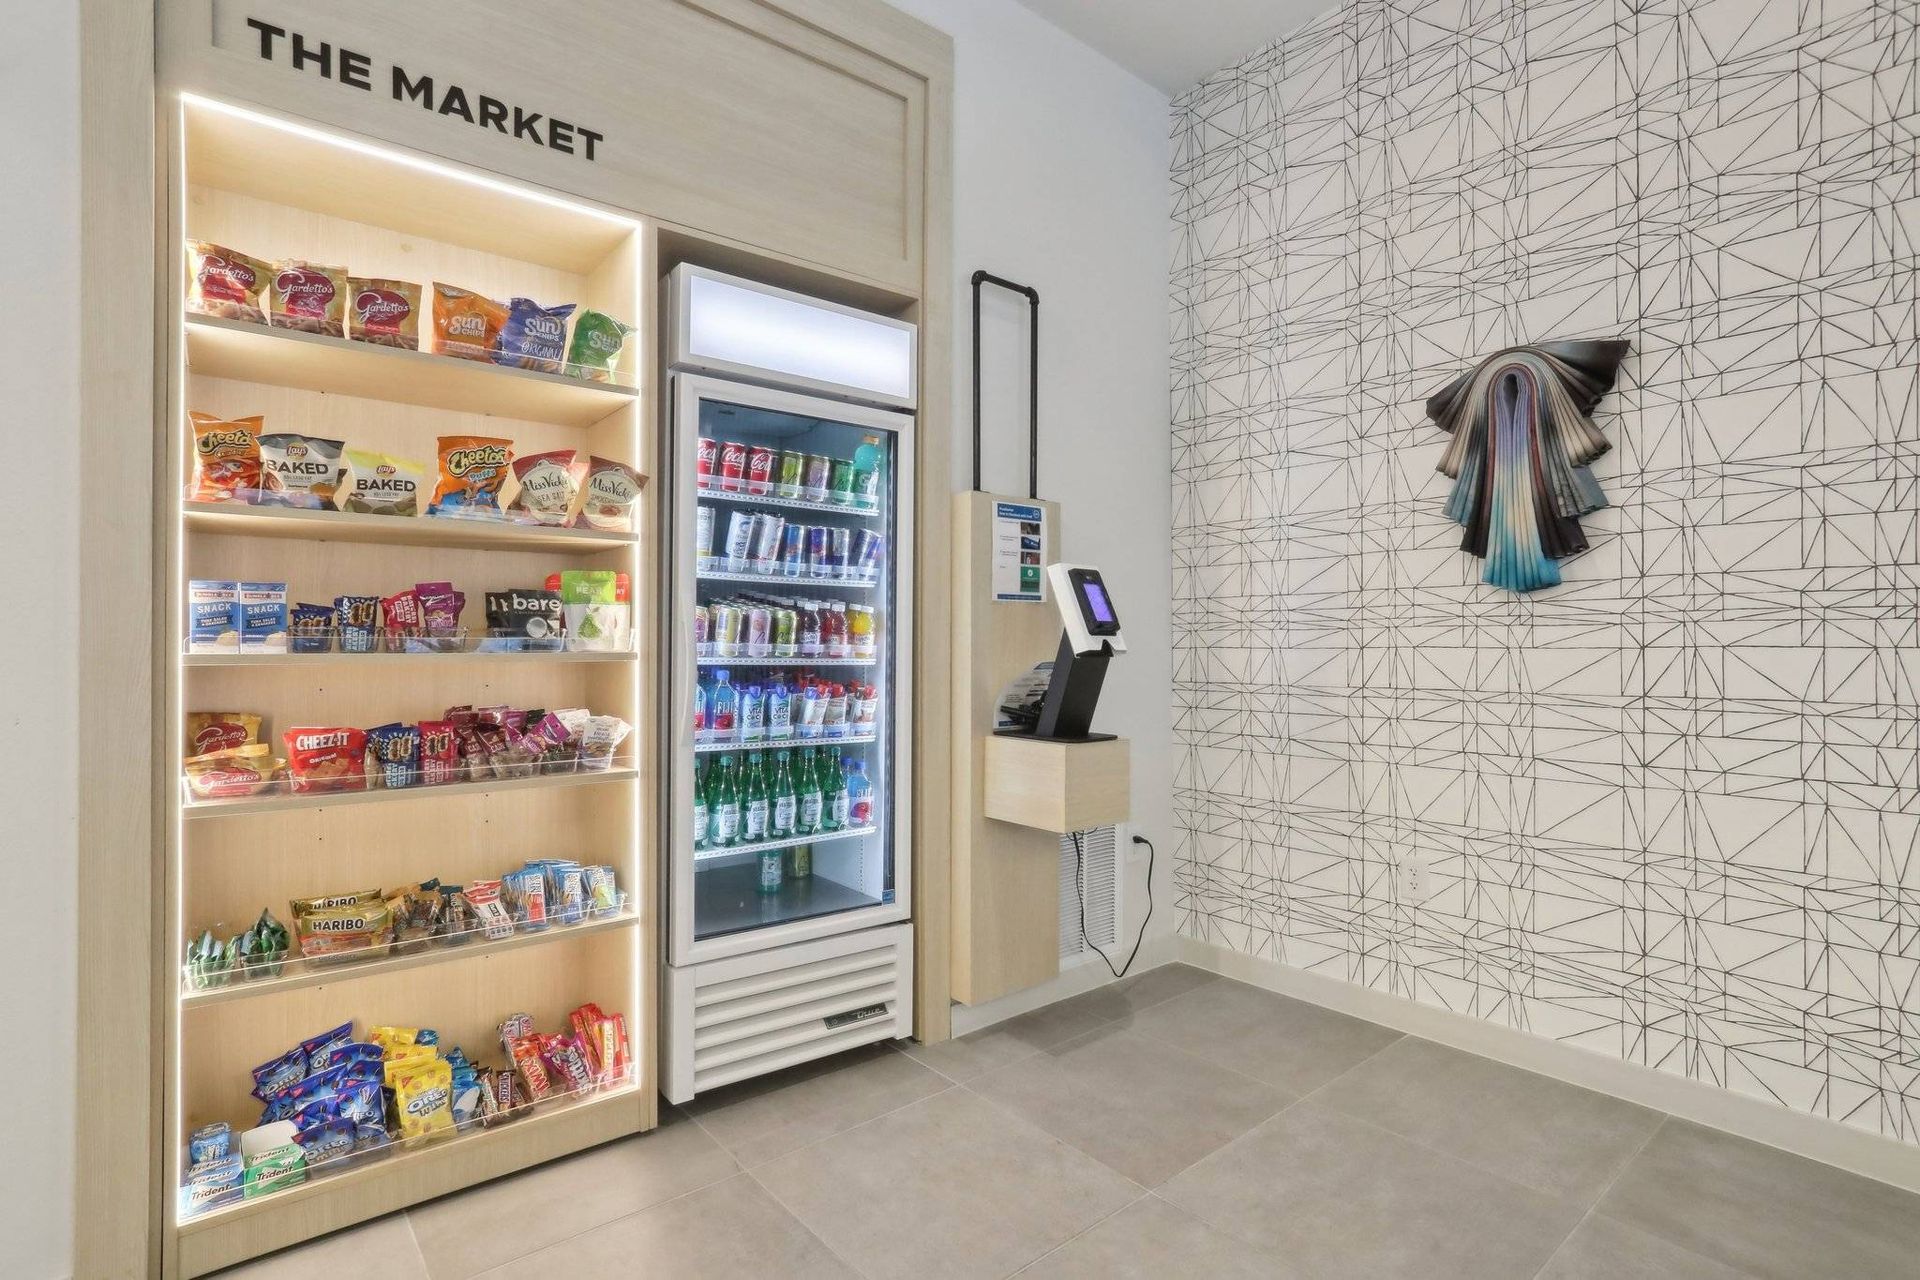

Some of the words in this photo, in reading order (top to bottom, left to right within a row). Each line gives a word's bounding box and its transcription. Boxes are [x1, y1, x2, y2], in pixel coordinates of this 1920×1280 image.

[247, 17, 372, 91] THE
[392, 65, 603, 161] MARKET
[276, 269, 333, 304] Gardetto's
[356, 292, 409, 323] Gardetto's
[461, 329, 485, 337] CHIPS
[538, 332, 560, 341] CHIPS
[265, 460, 328, 476] BAKED
[356, 479, 416, 492] BAKED
[522, 479, 546, 491] Miss
[590, 477, 612, 493] Miss
[197, 603, 231, 614] SNACK
[248, 604, 280, 614] SNACK
[512, 593, 560, 611] bare
[195, 727, 246, 753] Gardetto's
[313, 918, 365, 931] HARIBO
[313, 1053, 331, 1069] OR
[499, 1072, 510, 1103] SNICKERS
[408, 1089, 447, 1113] OREO
[250, 1148, 289, 1162] Trident
[257, 1166, 294, 1181] Trident
[192, 1184, 231, 1200] Trident
